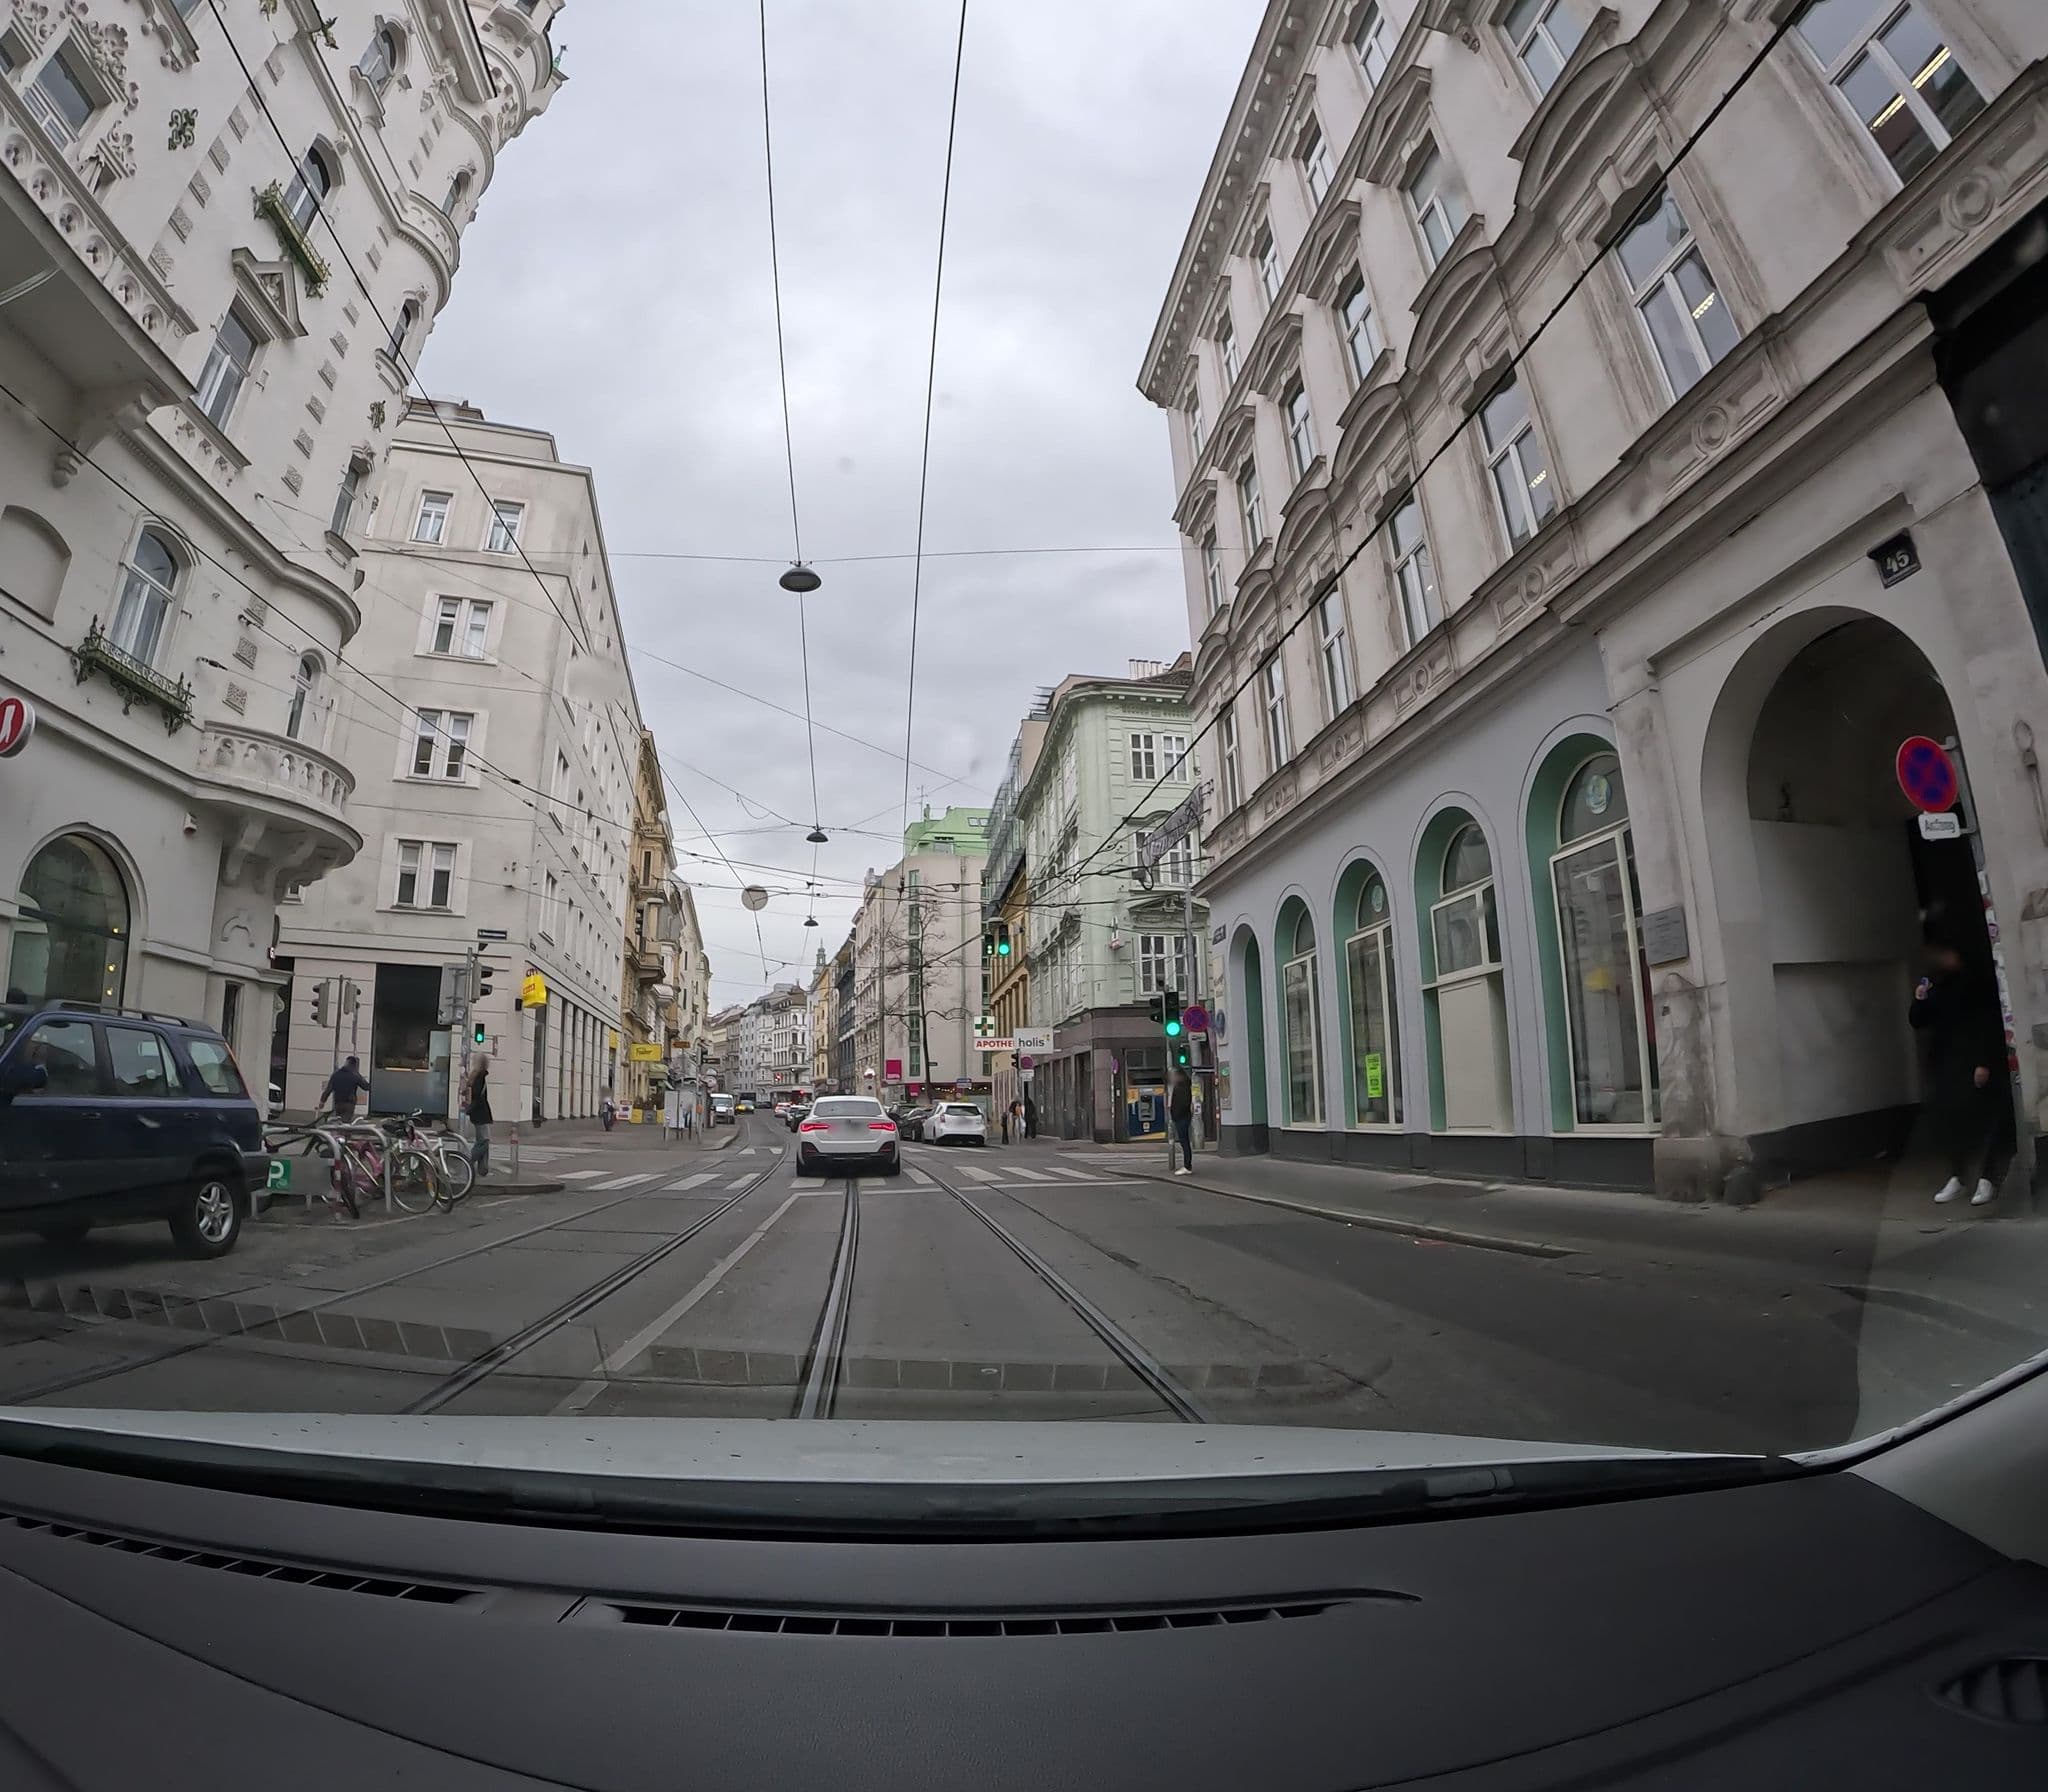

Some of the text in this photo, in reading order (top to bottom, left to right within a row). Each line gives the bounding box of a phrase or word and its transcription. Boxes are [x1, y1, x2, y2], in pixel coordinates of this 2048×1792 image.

[1886, 551, 1910, 572] 45
[976, 1040, 1015, 1048] APOTHE
[1018, 1037, 1045, 1047] holis
[267, 1160, 285, 1188] P
